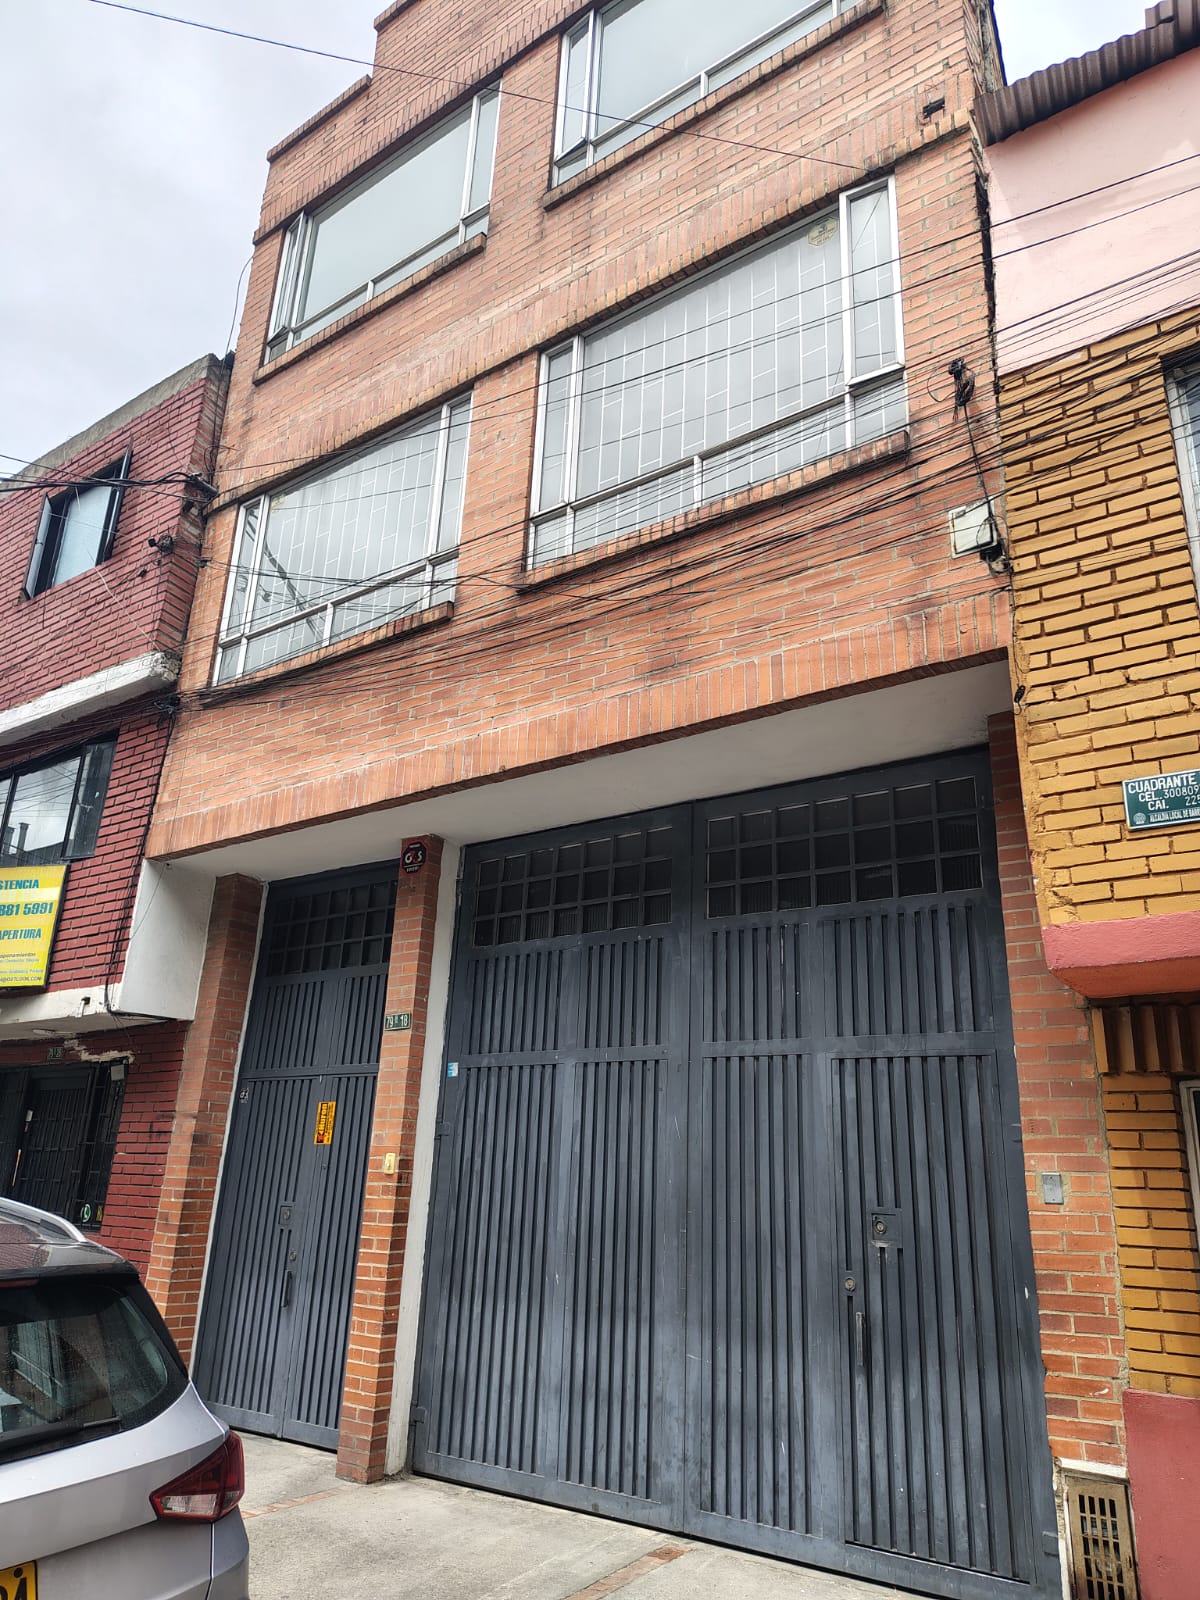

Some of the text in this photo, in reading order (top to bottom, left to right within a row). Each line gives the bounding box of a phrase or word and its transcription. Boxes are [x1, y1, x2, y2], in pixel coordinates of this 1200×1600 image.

[1128, 773, 1198, 794] CUADRANTE
[1138, 784, 1200, 802] CEL. 300809
[1148, 799, 1169, 811] CAI.
[23, 902, 54, 915] 5991
[386, 1016, 394, 1028] 79
[400, 1014, 408, 1027] 18
